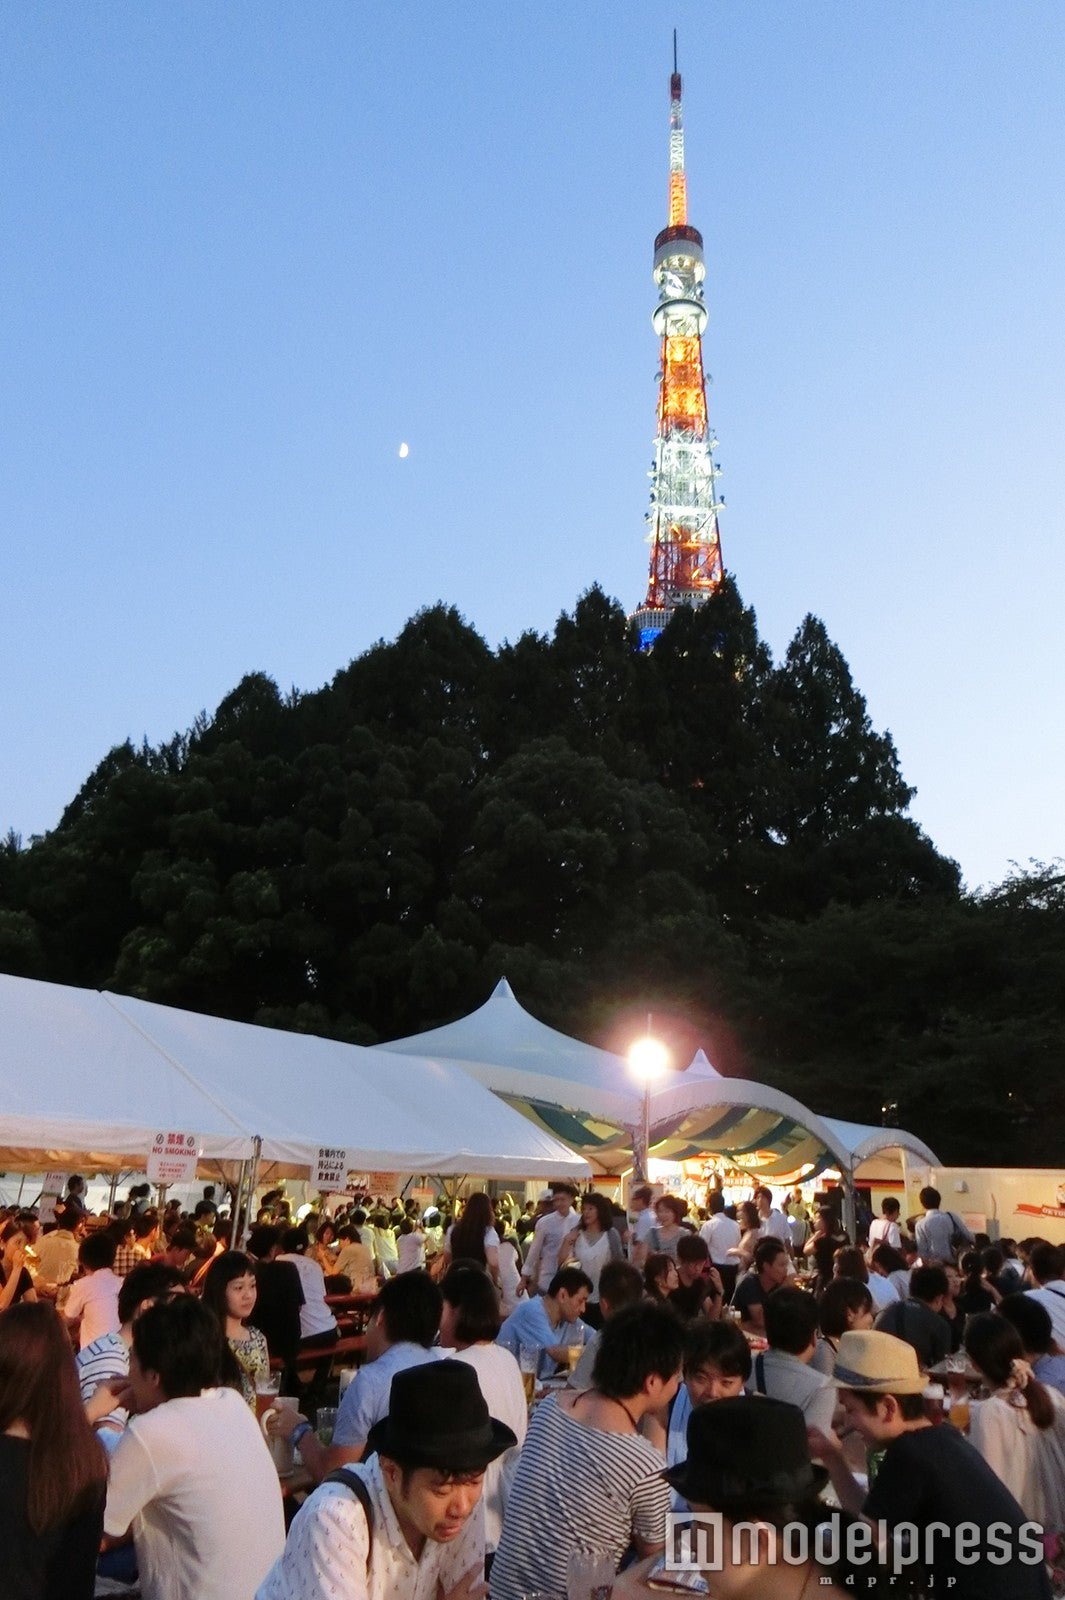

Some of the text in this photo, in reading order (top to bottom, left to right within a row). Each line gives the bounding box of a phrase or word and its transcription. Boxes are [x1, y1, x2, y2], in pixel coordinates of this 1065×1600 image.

[167, 1133, 185, 1145] 禁煙
[152, 1146, 197, 1156] NO SMOKING
